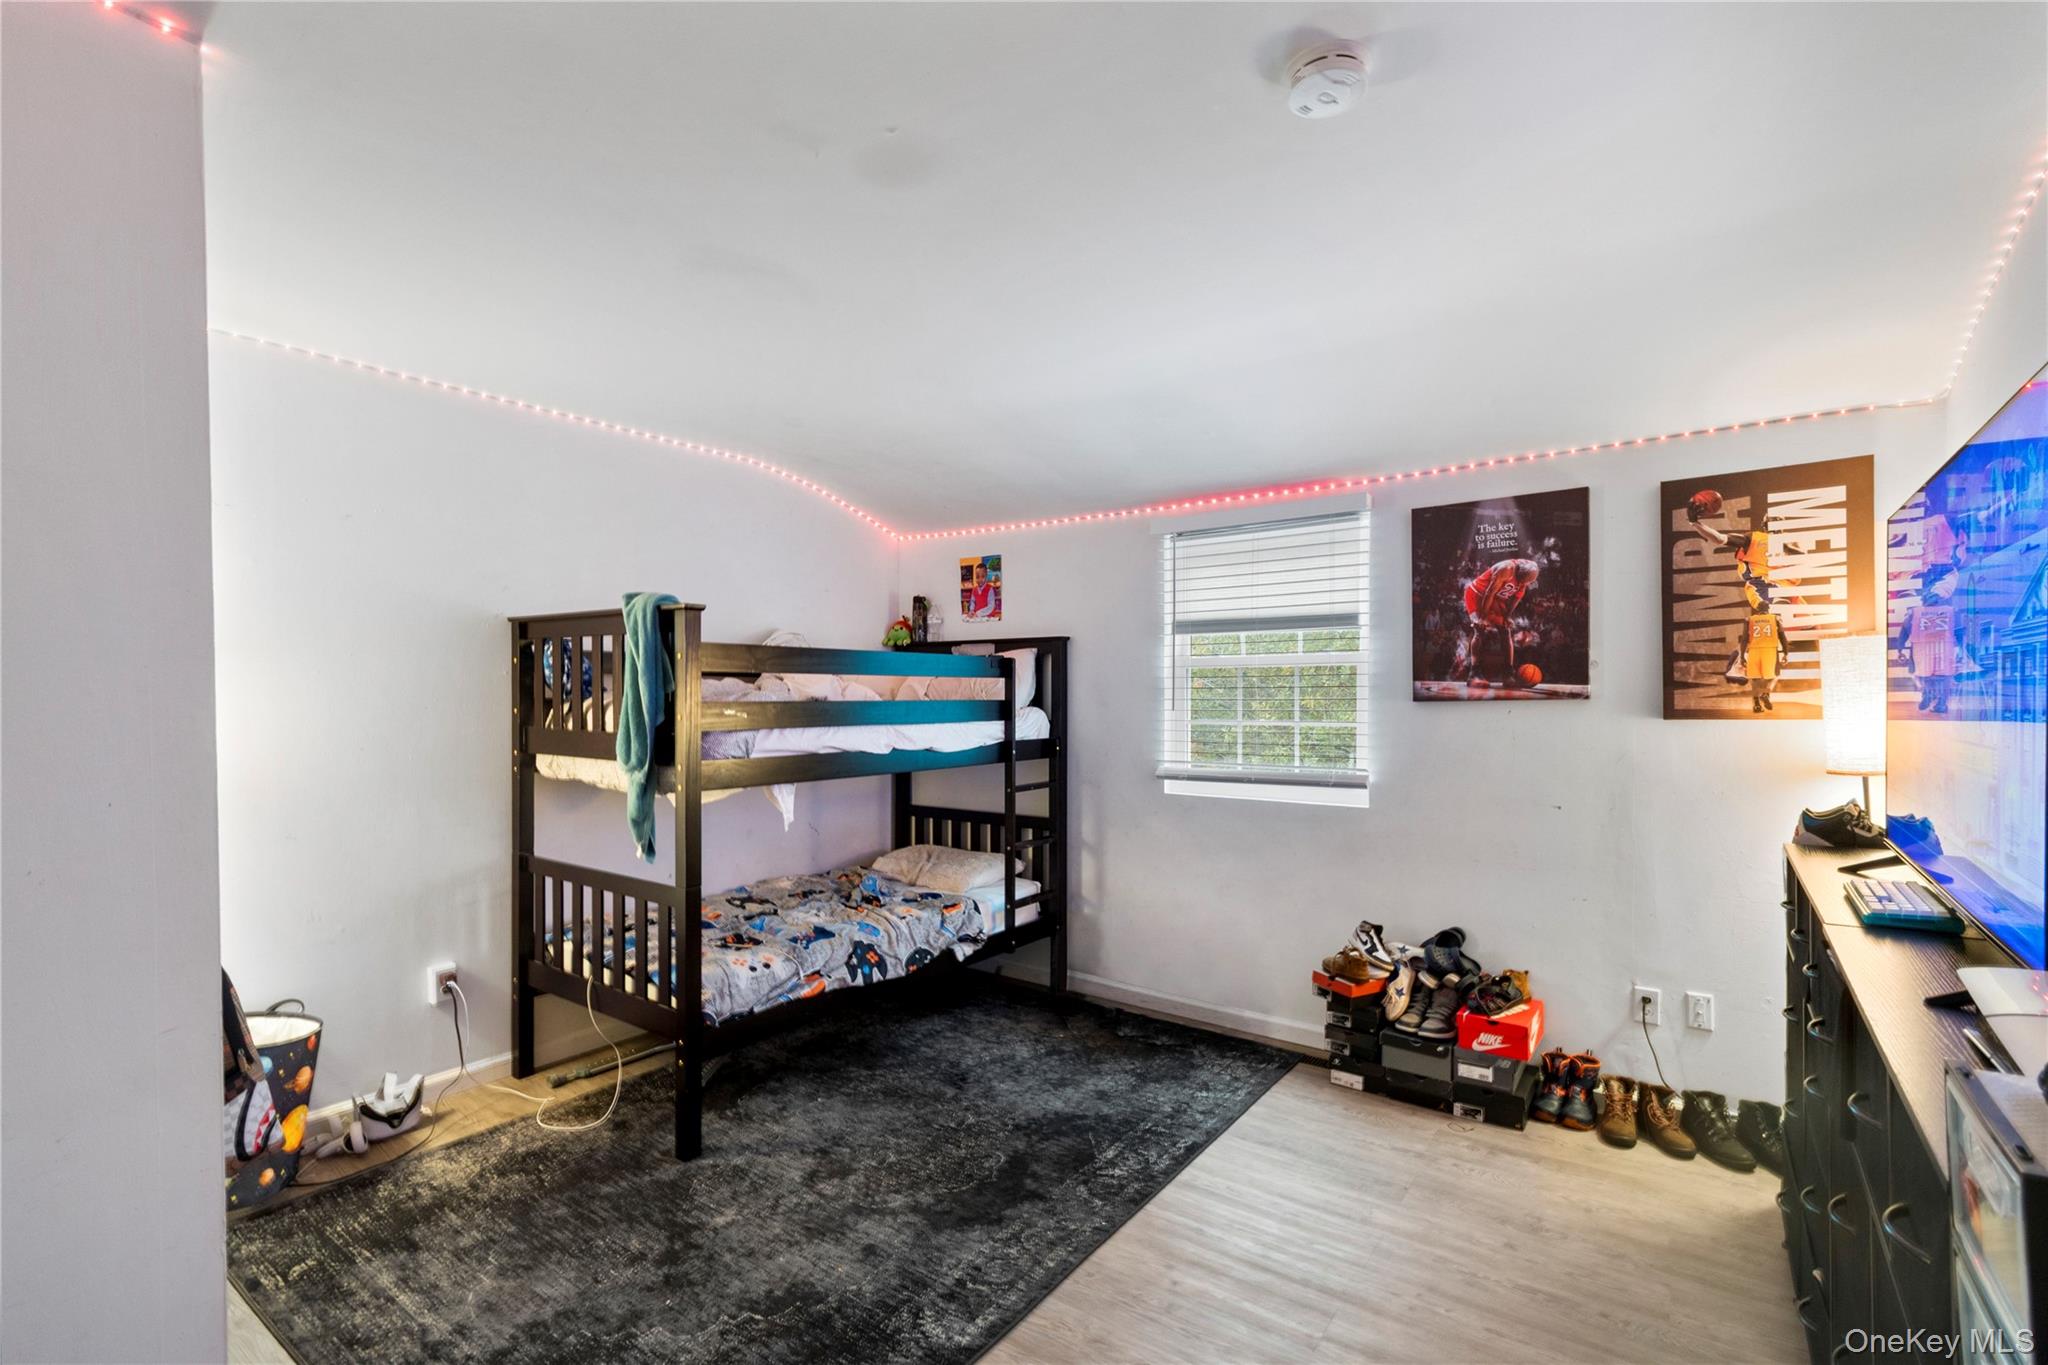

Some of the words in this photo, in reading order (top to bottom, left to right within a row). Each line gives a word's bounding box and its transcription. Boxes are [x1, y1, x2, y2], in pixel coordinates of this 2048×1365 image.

[1478, 524, 1496, 533] The
[1498, 522, 1515, 533] key
[1486, 531, 1518, 540] success
[1477, 541, 1485, 549] is
[1486, 539, 1518, 548] failure.
[1753, 624, 1771, 638] 24
[1477, 1032, 1504, 1046] NIKE
